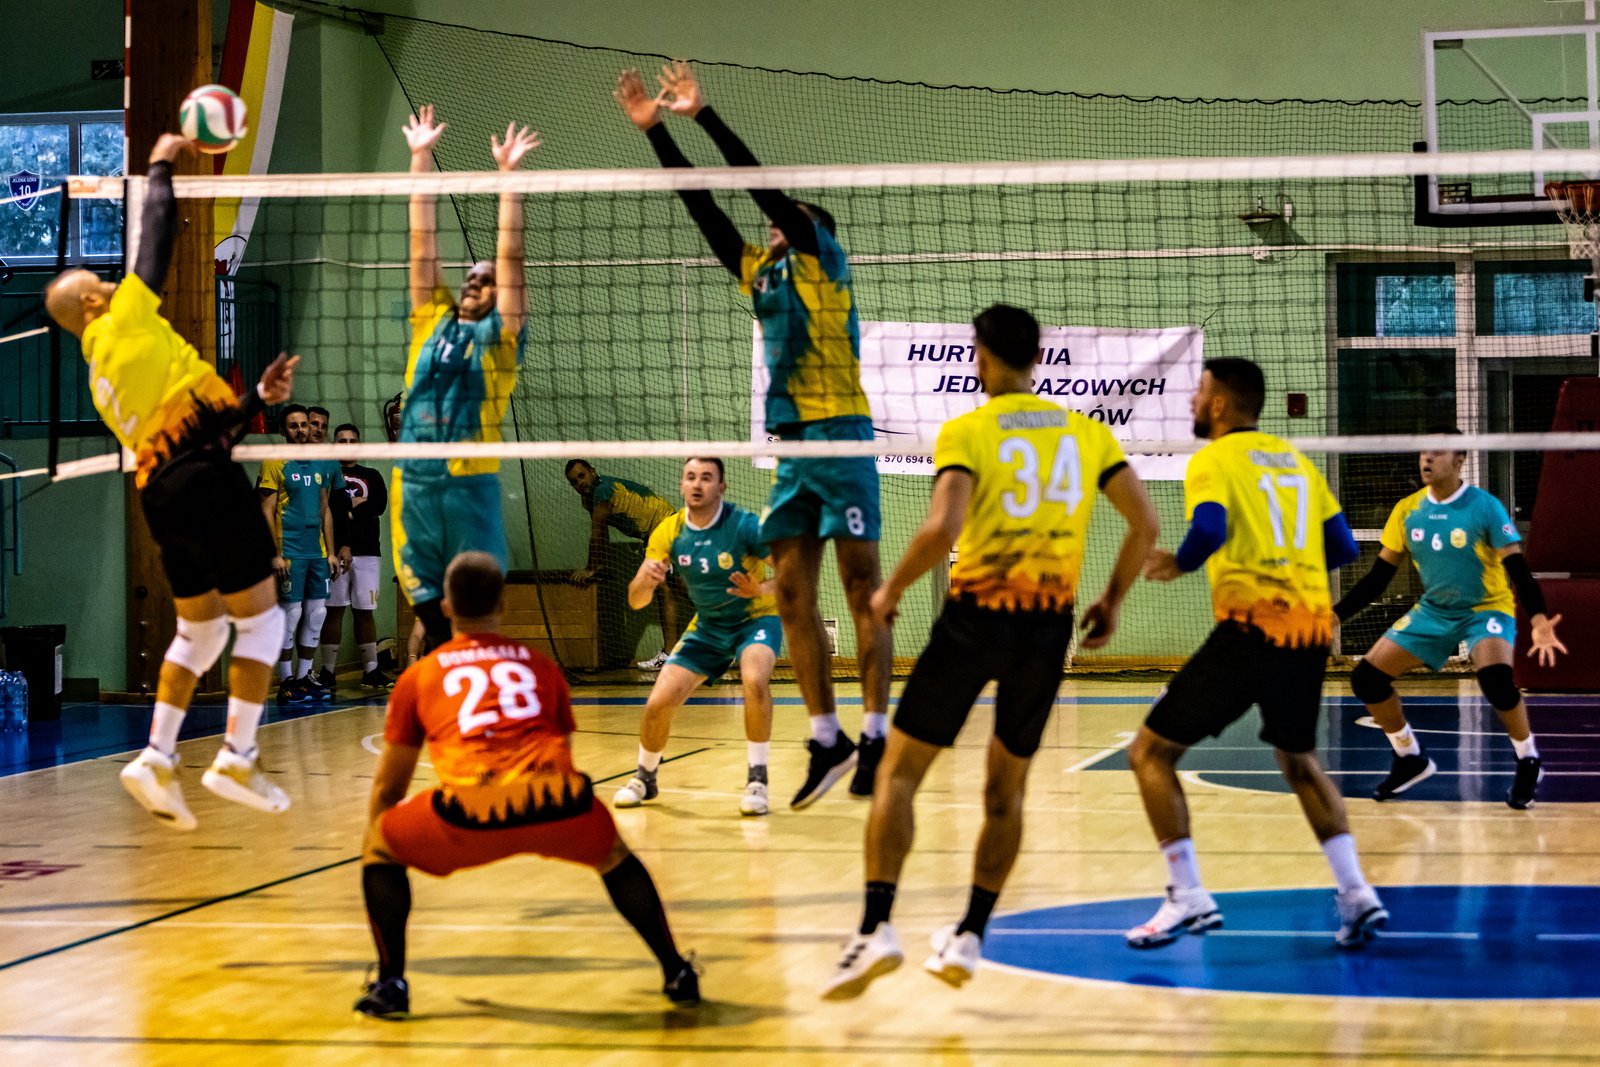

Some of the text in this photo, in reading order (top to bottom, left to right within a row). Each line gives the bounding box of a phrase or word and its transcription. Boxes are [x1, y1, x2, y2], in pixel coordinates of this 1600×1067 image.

[19, 185, 31, 196] 10
[908, 344, 1071, 365] HURTIA
[933, 375, 1166, 396] JEDAZOWYCH
[884, 454, 903, 463] 570
[905, 455, 924, 464] 694
[303, 475, 311, 486] 17
[998, 434, 1083, 518] 34
[845, 506, 865, 536] 8
[1257, 474, 1308, 549] 17
[1431, 533, 1443, 551] 6
[699, 557, 710, 574] 3
[1486, 617, 1503, 634] 6
[443, 661, 542, 735] 28
